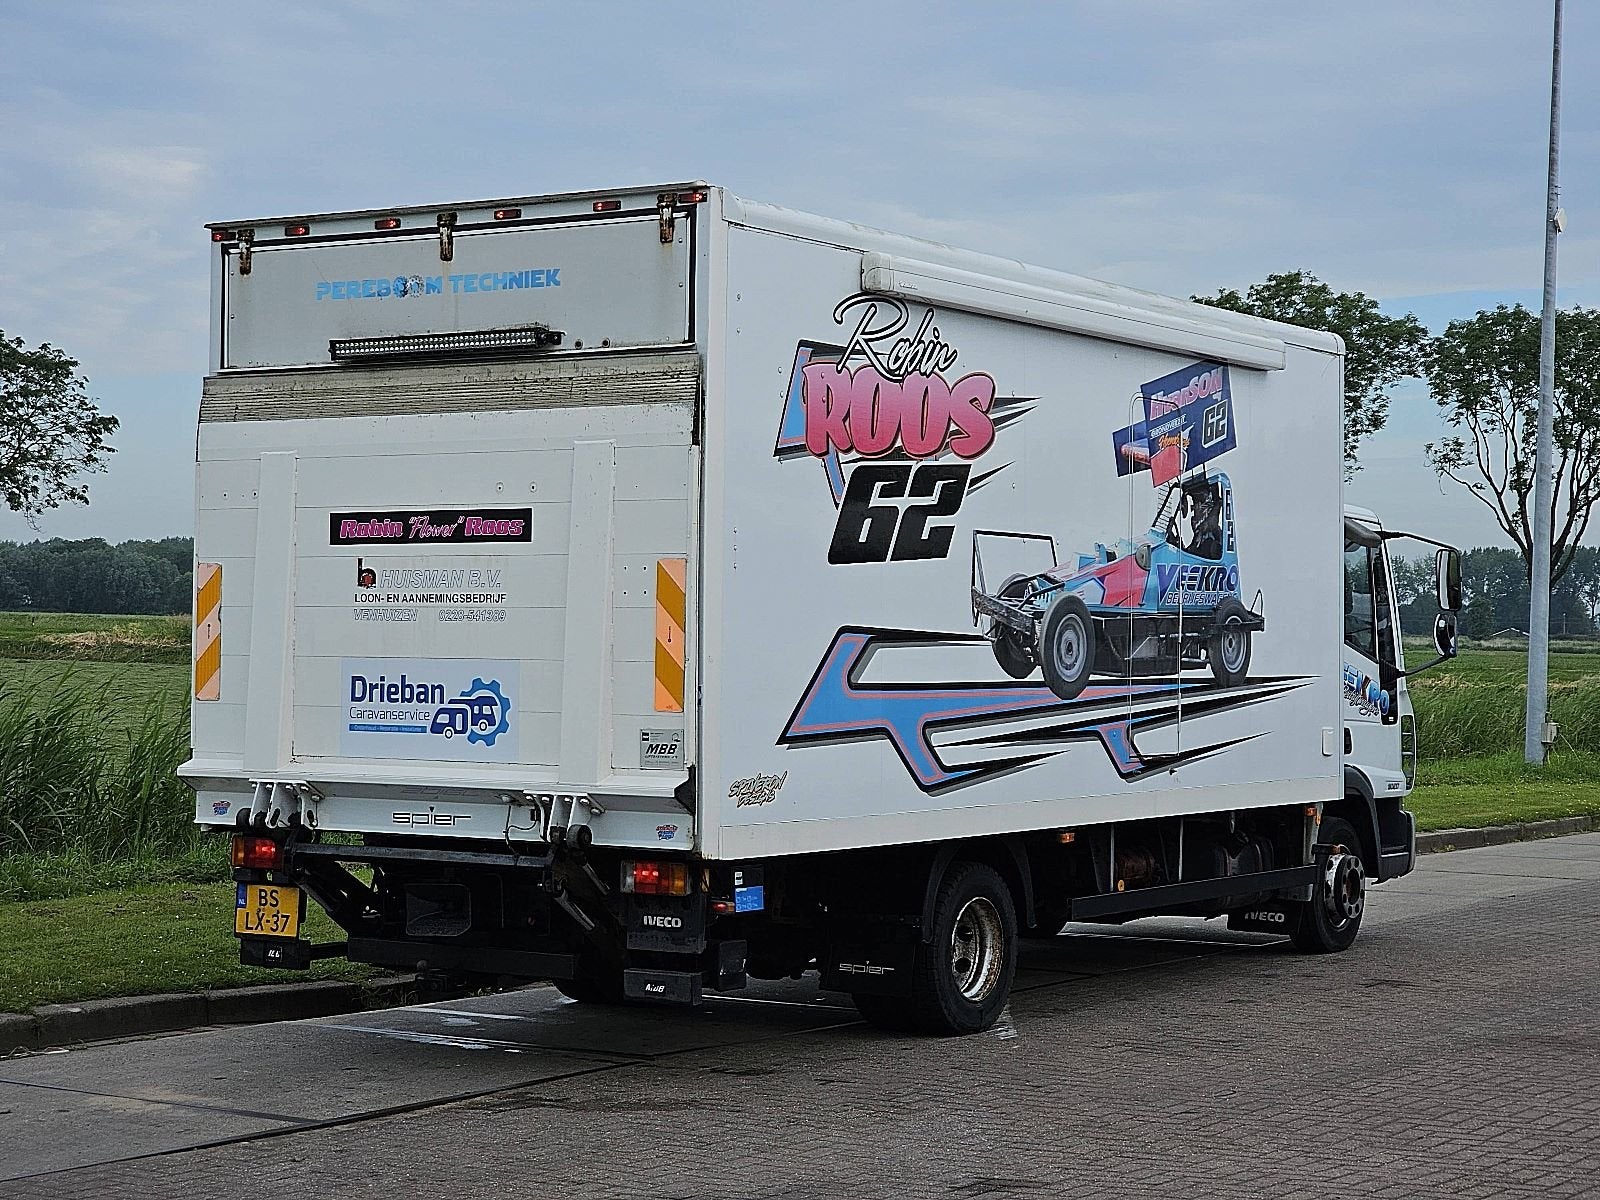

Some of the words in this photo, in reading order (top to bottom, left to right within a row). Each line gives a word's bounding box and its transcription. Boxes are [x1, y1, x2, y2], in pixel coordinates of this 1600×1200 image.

[448, 268, 561, 293] TECHNIEK
[832, 292, 958, 384] Robin
[802, 361, 996, 460] ROOS
[1203, 401, 1228, 447] 62
[828, 464, 972, 564] 62
[340, 519, 404, 538] Robin
[464, 517, 525, 536] Roos
[379, 569, 464, 589] HUISMAN
[468, 569, 502, 588] B.V.
[354, 594, 385, 604] LOON-
[386, 594, 400, 604] EN
[401, 593, 507, 604] AANNEMINGSBEDRIJF
[353, 609, 418, 621] VENHUIZEN
[350, 675, 445, 704] Drieban
[349, 707, 430, 721] Caravanservice
[645, 743, 678, 755] MBB
[392, 806, 472, 828] spier
[258, 888, 279, 908] BS
[245, 911, 291, 933] LX-37
[643, 915, 682, 928] IVECO
[1244, 910, 1285, 922] IVECO
[839, 960, 895, 975] spier
